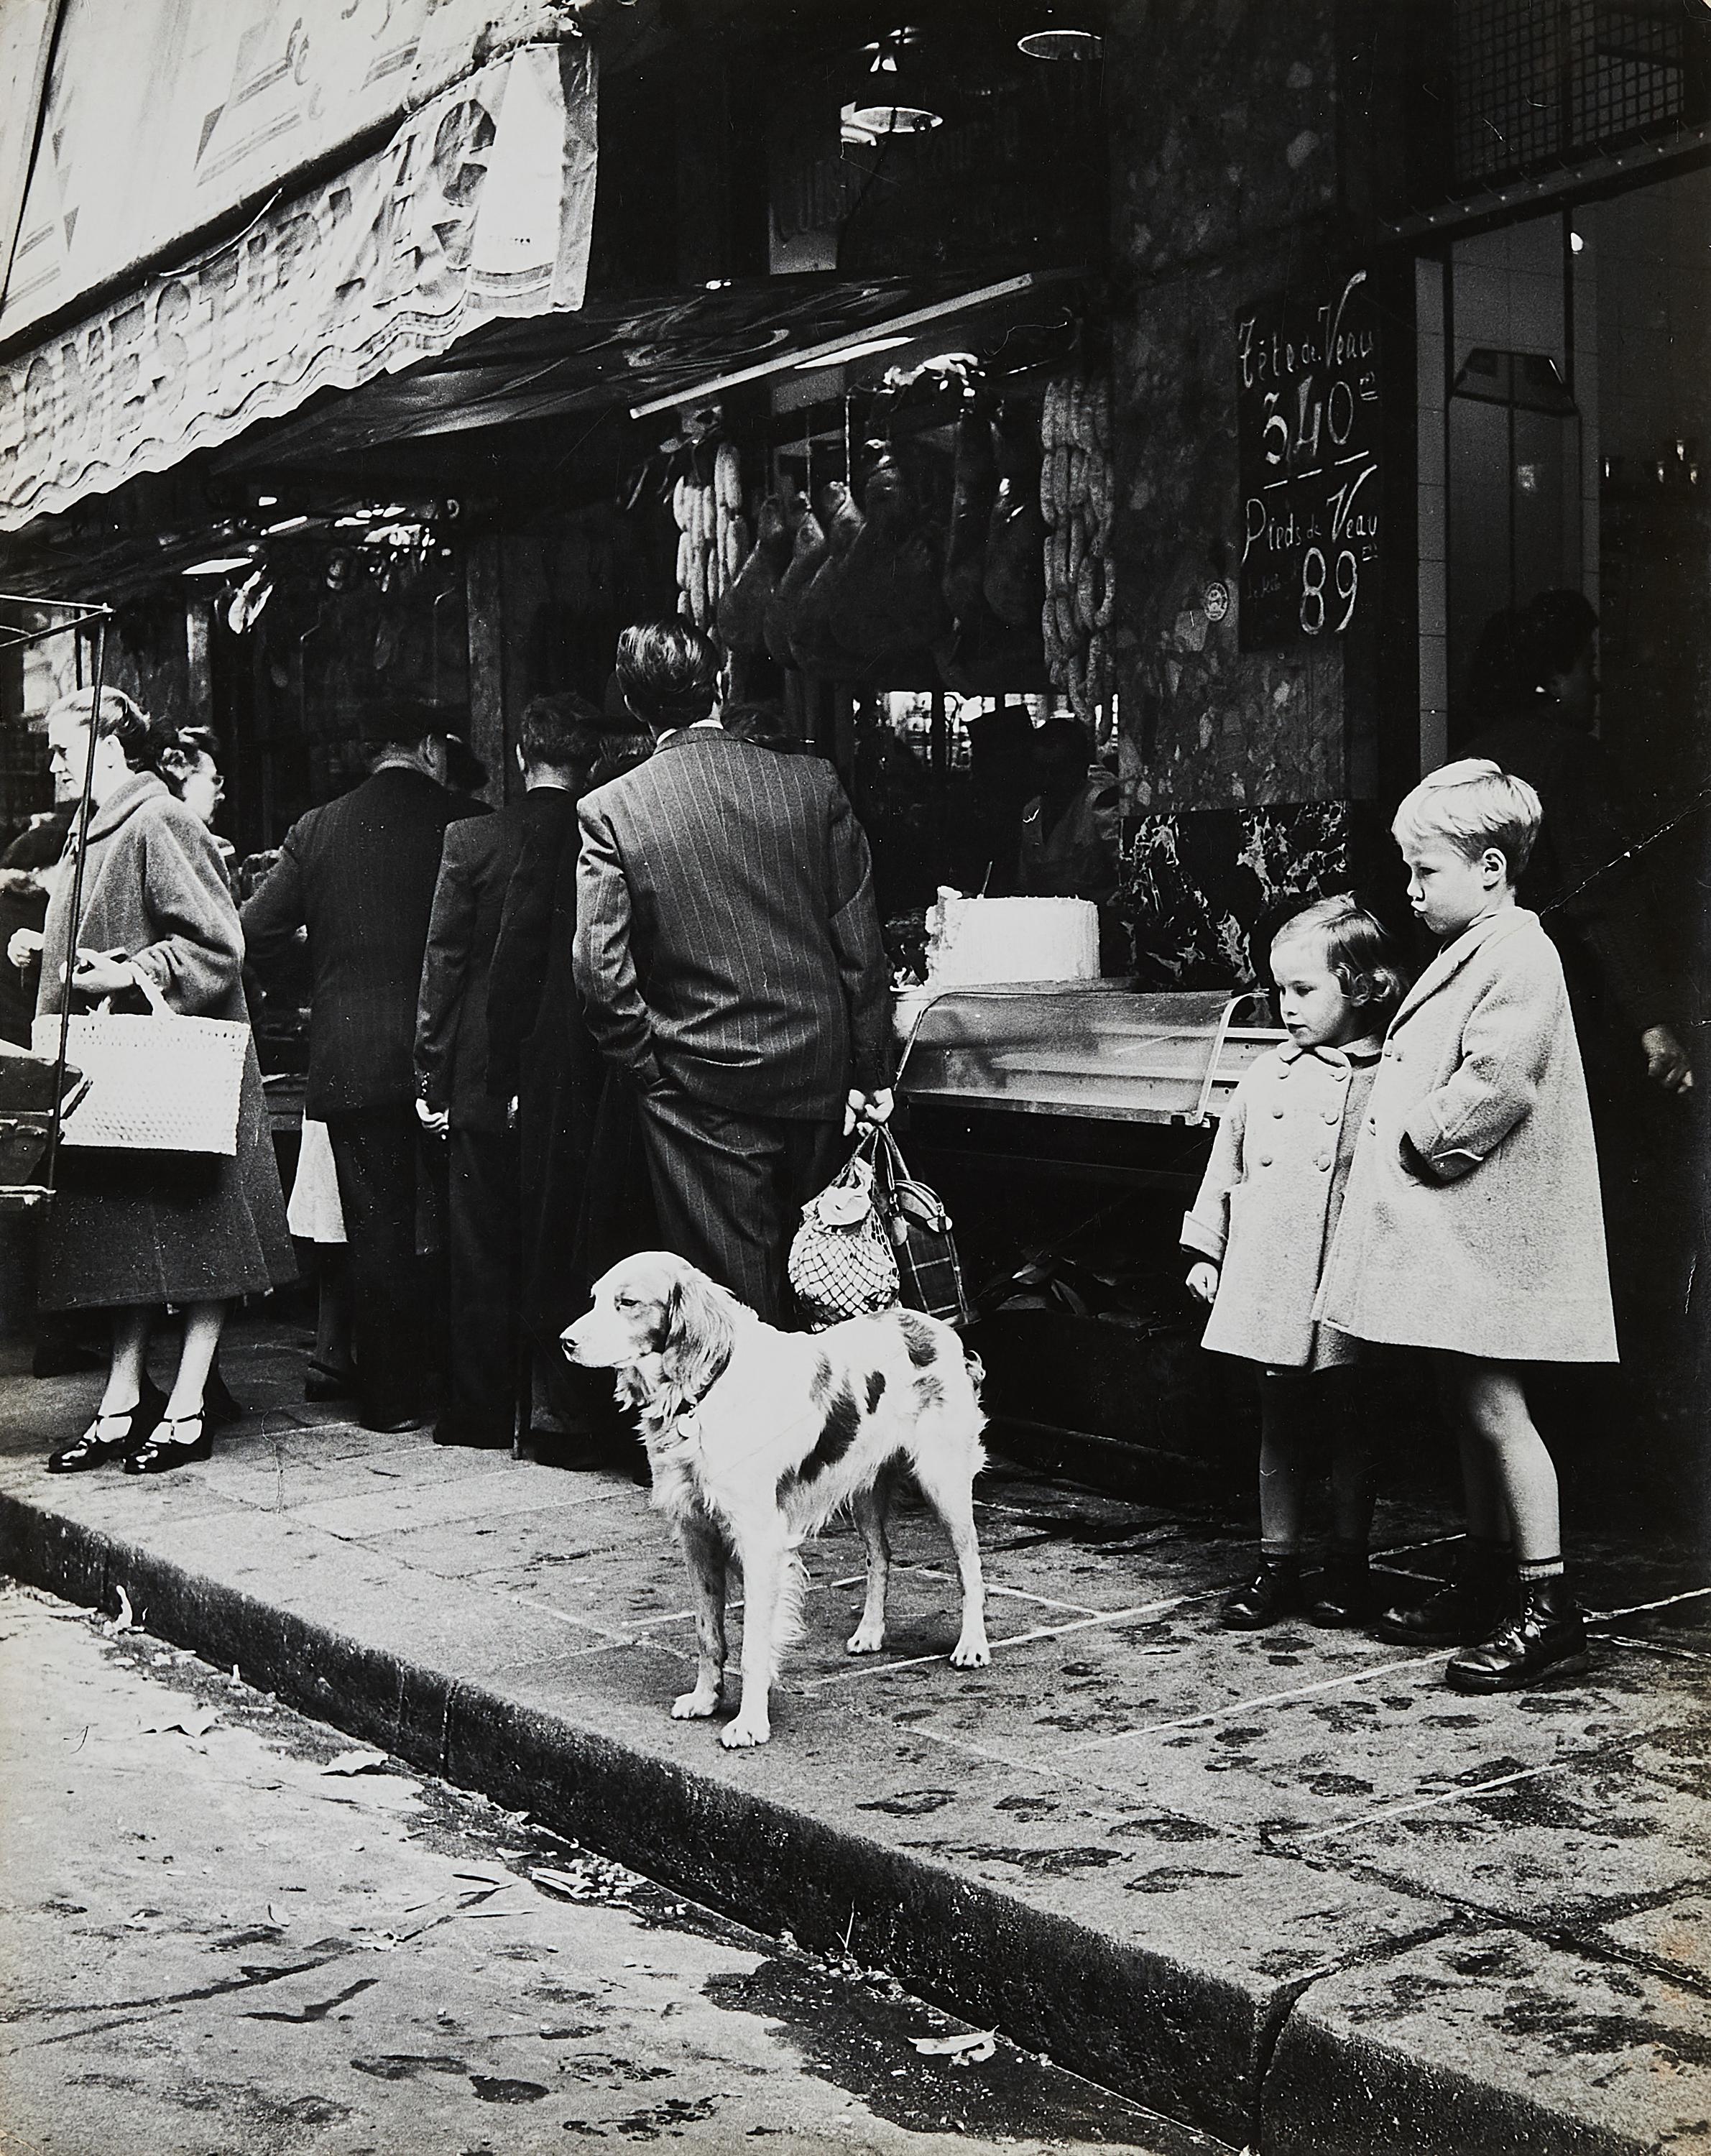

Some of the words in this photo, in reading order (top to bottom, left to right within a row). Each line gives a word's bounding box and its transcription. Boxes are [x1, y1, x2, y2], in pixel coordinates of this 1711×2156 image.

[1317, 270, 1374, 368] Veau
[1263, 375, 1353, 465] 340
[1242, 499, 1302, 566] Pieds
[1306, 514, 1322, 539] de
[1326, 464, 1378, 543] Veau
[1299, 547, 1357, 635] 89
